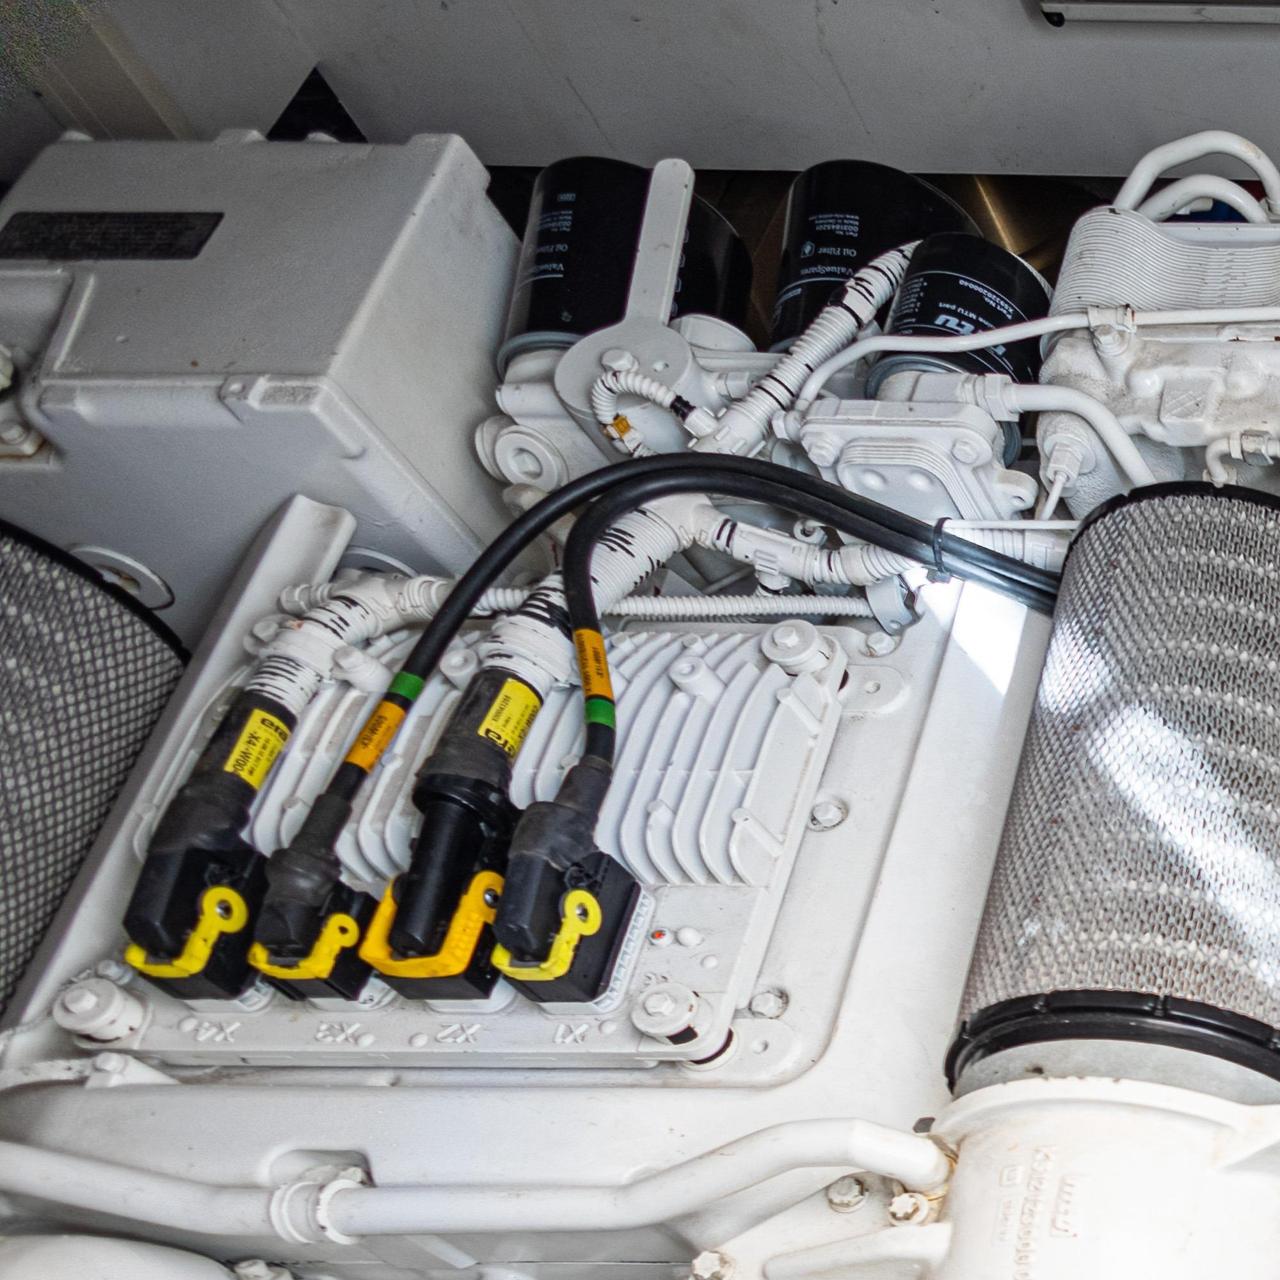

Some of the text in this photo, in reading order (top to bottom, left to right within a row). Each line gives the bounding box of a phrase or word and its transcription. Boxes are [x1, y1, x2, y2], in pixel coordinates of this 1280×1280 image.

[817, 246, 857, 257] Oil Filter
[939, 302, 977, 320] MTU part
[996, 304, 1013, 320] Part
[197, 1022, 241, 1042] X4
[315, 1022, 361, 1042] X3
[436, 1023, 482, 1043] X2
[552, 1022, 590, 1044] X1
